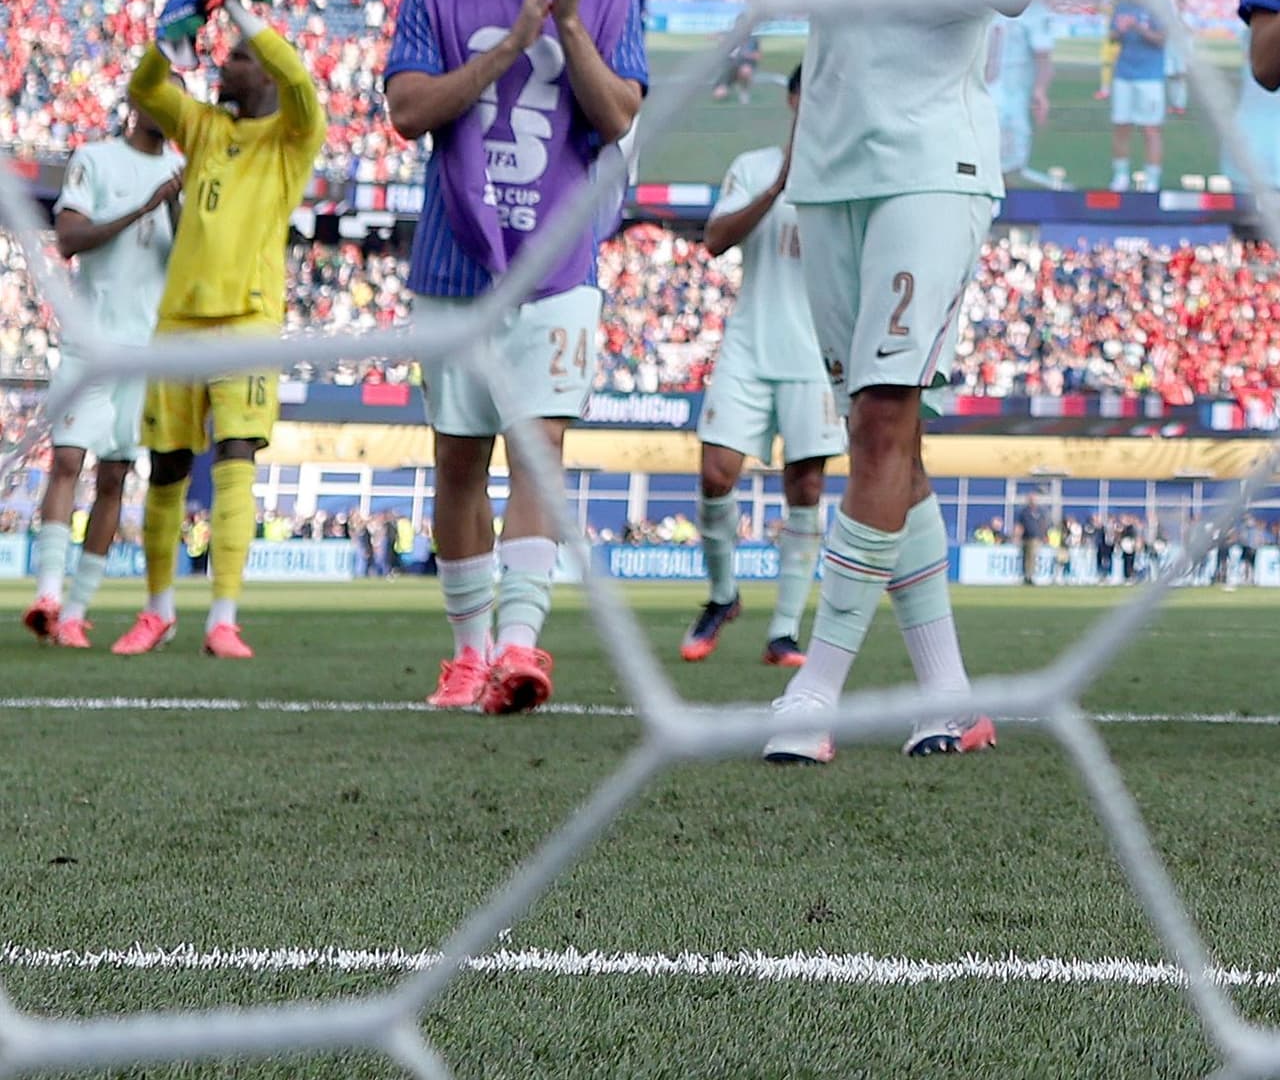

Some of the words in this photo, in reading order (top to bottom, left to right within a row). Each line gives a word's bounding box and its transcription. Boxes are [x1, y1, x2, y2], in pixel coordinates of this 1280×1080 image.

[485, 149, 518, 169] IFA
[197, 179, 221, 212] 16
[505, 189, 541, 206] CUP
[887, 271, 915, 336] 2
[549, 327, 588, 377] 24
[245, 375, 267, 406] 16
[610, 547, 708, 577] FOOTBALL
